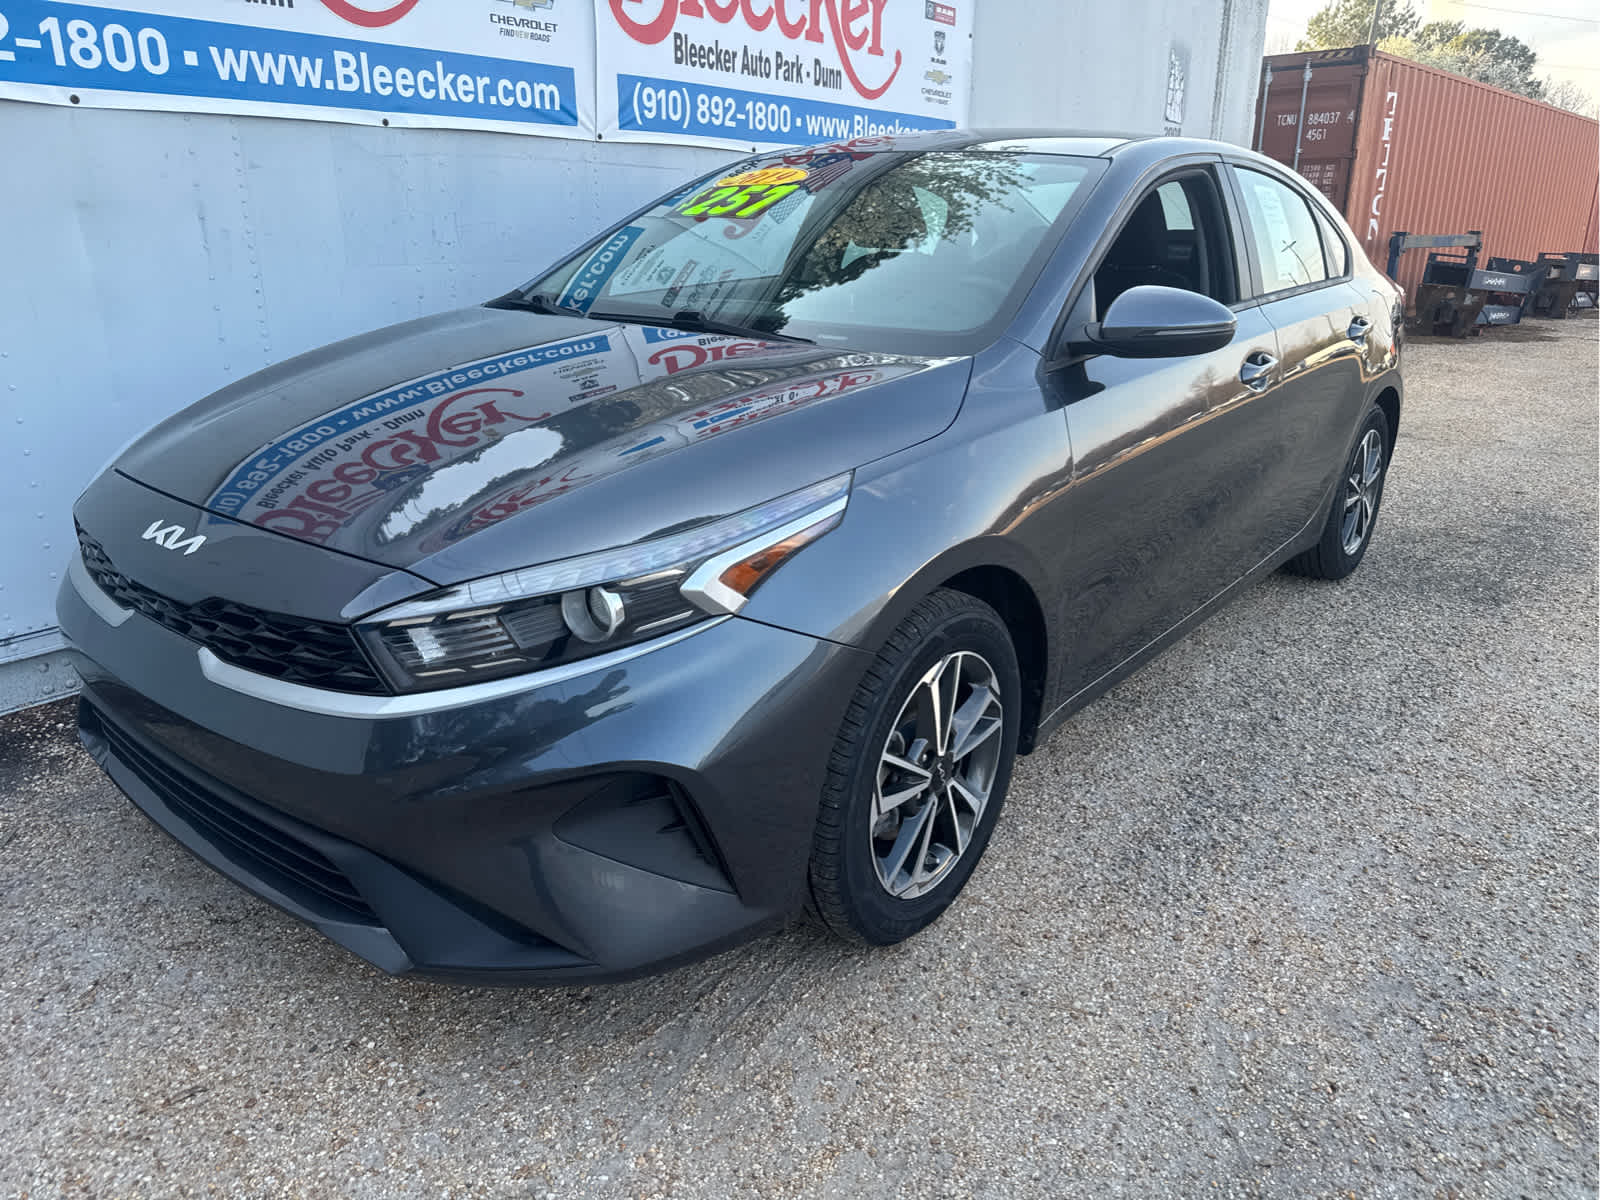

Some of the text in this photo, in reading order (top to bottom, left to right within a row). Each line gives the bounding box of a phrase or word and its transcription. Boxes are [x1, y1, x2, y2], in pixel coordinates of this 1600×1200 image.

[489, 13, 558, 33] CHEVROLET
[209, 45, 561, 111] www.Bleecker.com
[673, 32, 842, 90] Bleecker Auto Park Dunn
[633, 81, 691, 129] (910)
[696, 93, 791, 133] 892-1800
[1307, 111, 1341, 126] 884037
[1306, 128, 1327, 141] 45G1
[141, 519, 207, 556] KIA
